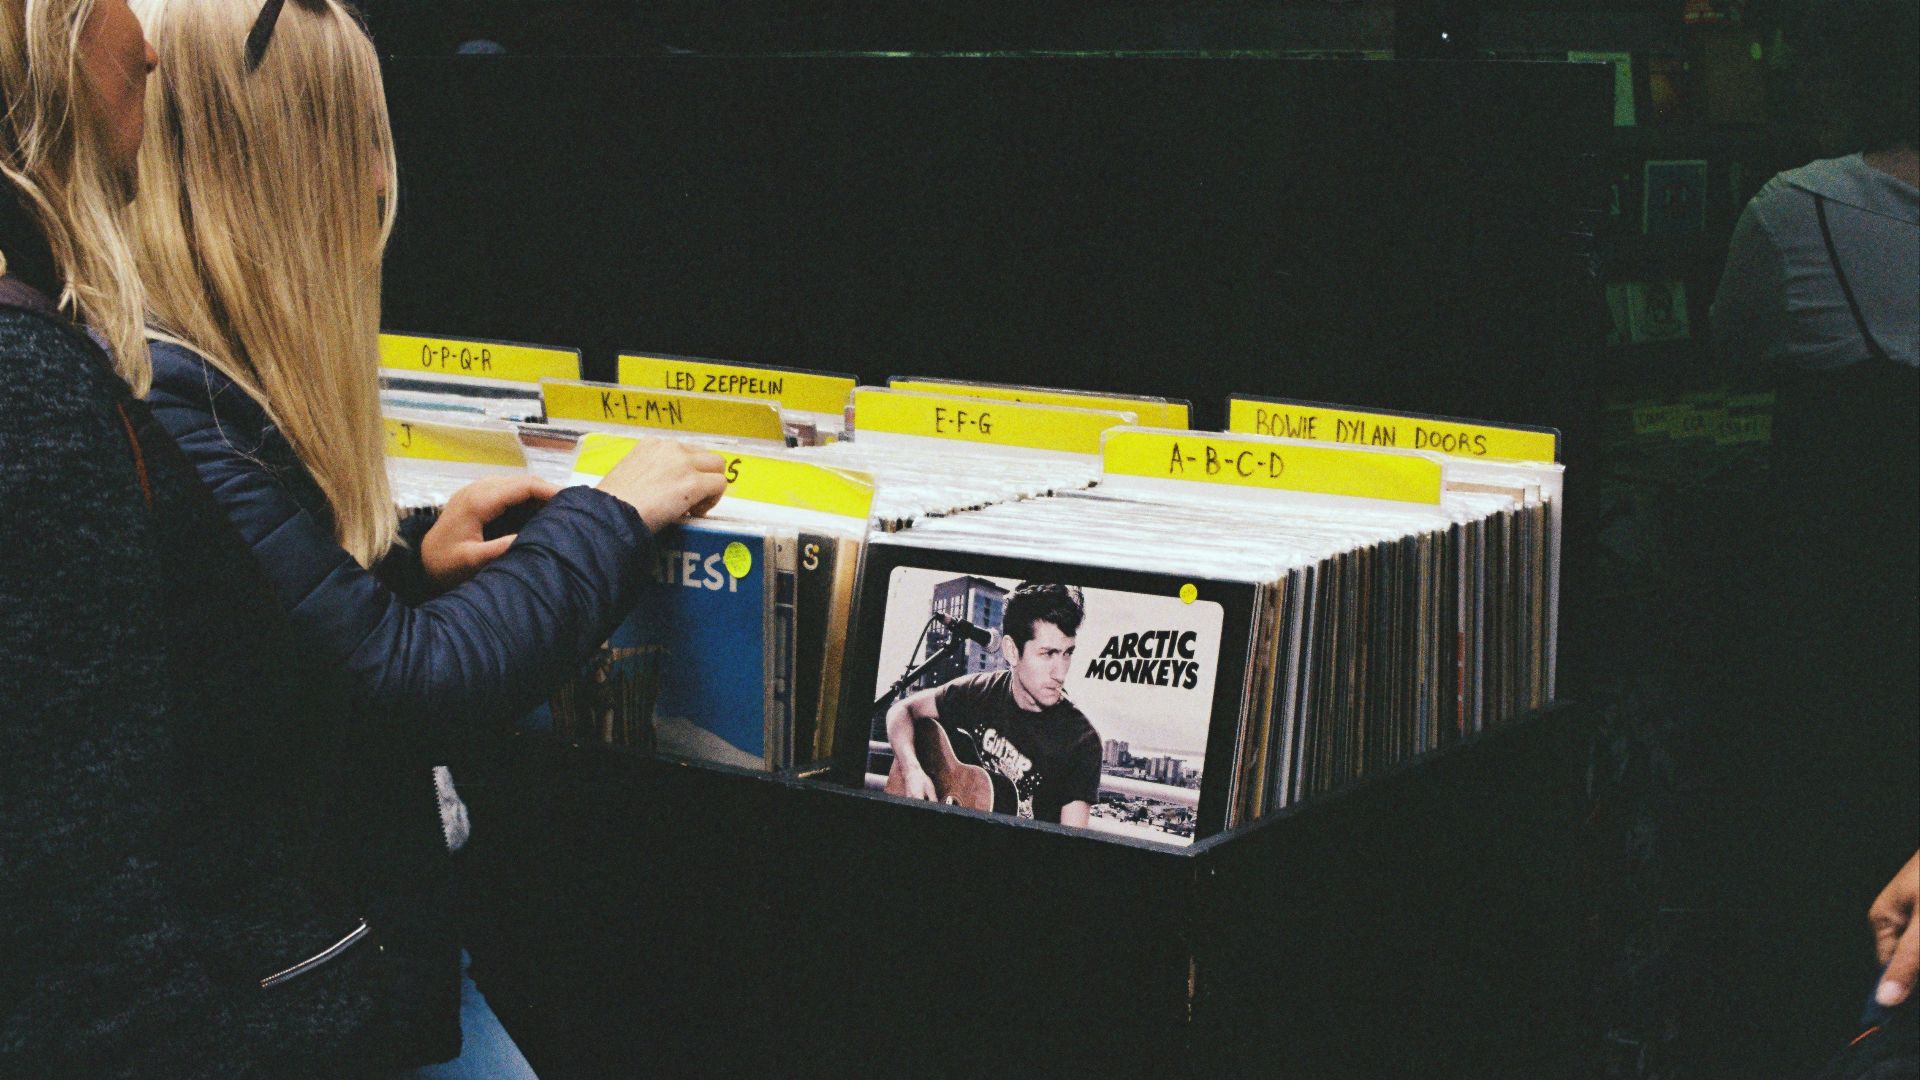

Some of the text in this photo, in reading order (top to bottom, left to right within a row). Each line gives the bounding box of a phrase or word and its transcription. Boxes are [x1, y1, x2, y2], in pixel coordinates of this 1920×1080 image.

[422, 344, 492, 372] O-P-Q-R
[666, 370, 783, 395] LED ZEPPELIN
[601, 391, 682, 425] K-L-M-N
[935, 407, 993, 435] E-F-G
[1256, 398, 1487, 456] BOWIE DYLAN DOORS
[1169, 442, 1284, 479] A-B-C-D
[1098, 630, 1197, 659] ARCTIC
[1085, 658, 1199, 690] MONKEYS
